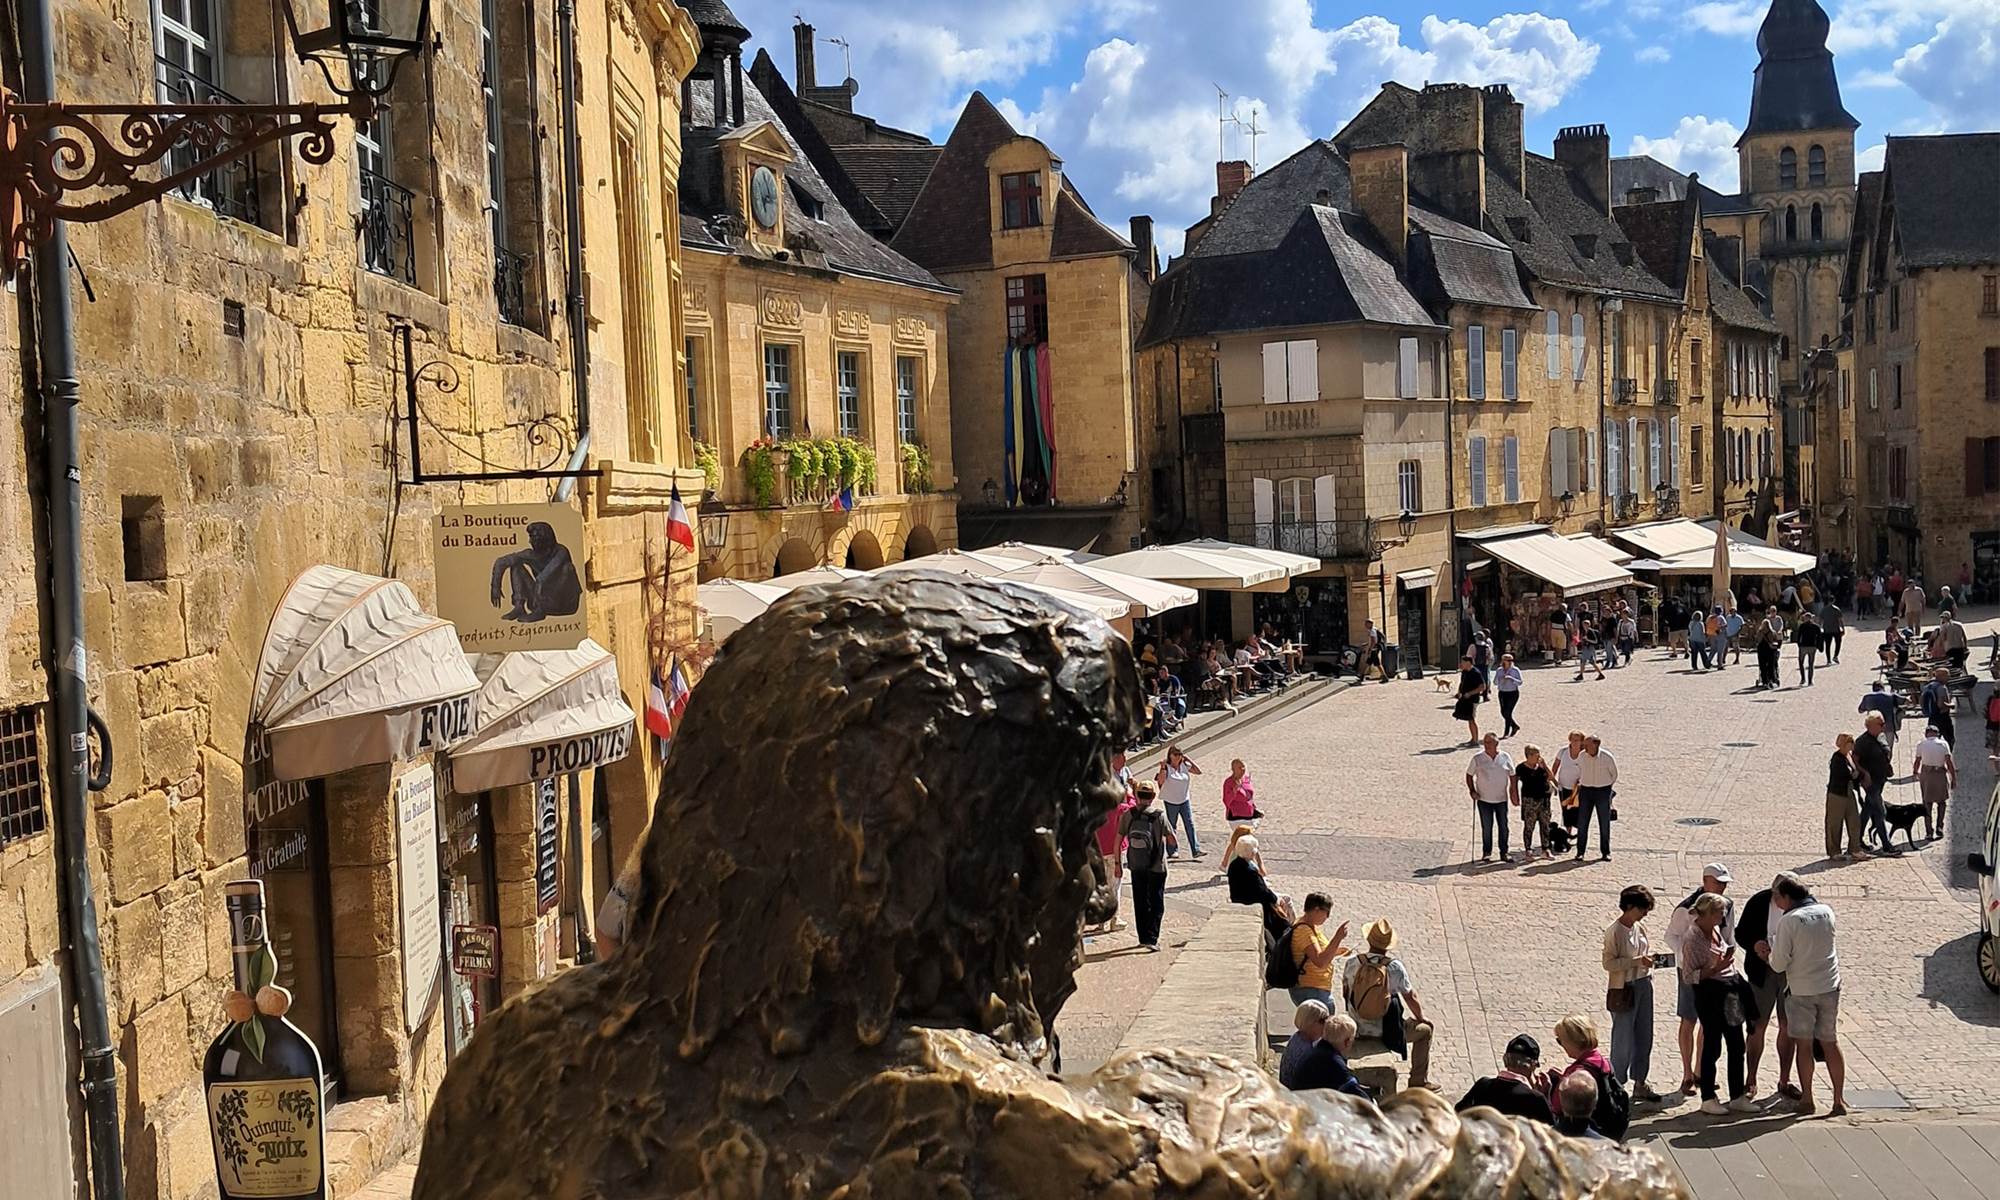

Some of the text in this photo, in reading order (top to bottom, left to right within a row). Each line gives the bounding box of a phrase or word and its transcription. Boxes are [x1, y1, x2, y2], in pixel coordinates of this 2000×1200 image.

[441, 514, 529, 529] La Boutique
[442, 533, 518, 547] du Badaud
[458, 622, 581, 645] roduits Régionaux
[419, 697, 470, 748] FOIE
[529, 726, 625, 779] PRODUITS
[266, 832, 308, 870] Gratuite
[240, 1118, 296, 1146] Quinqui
